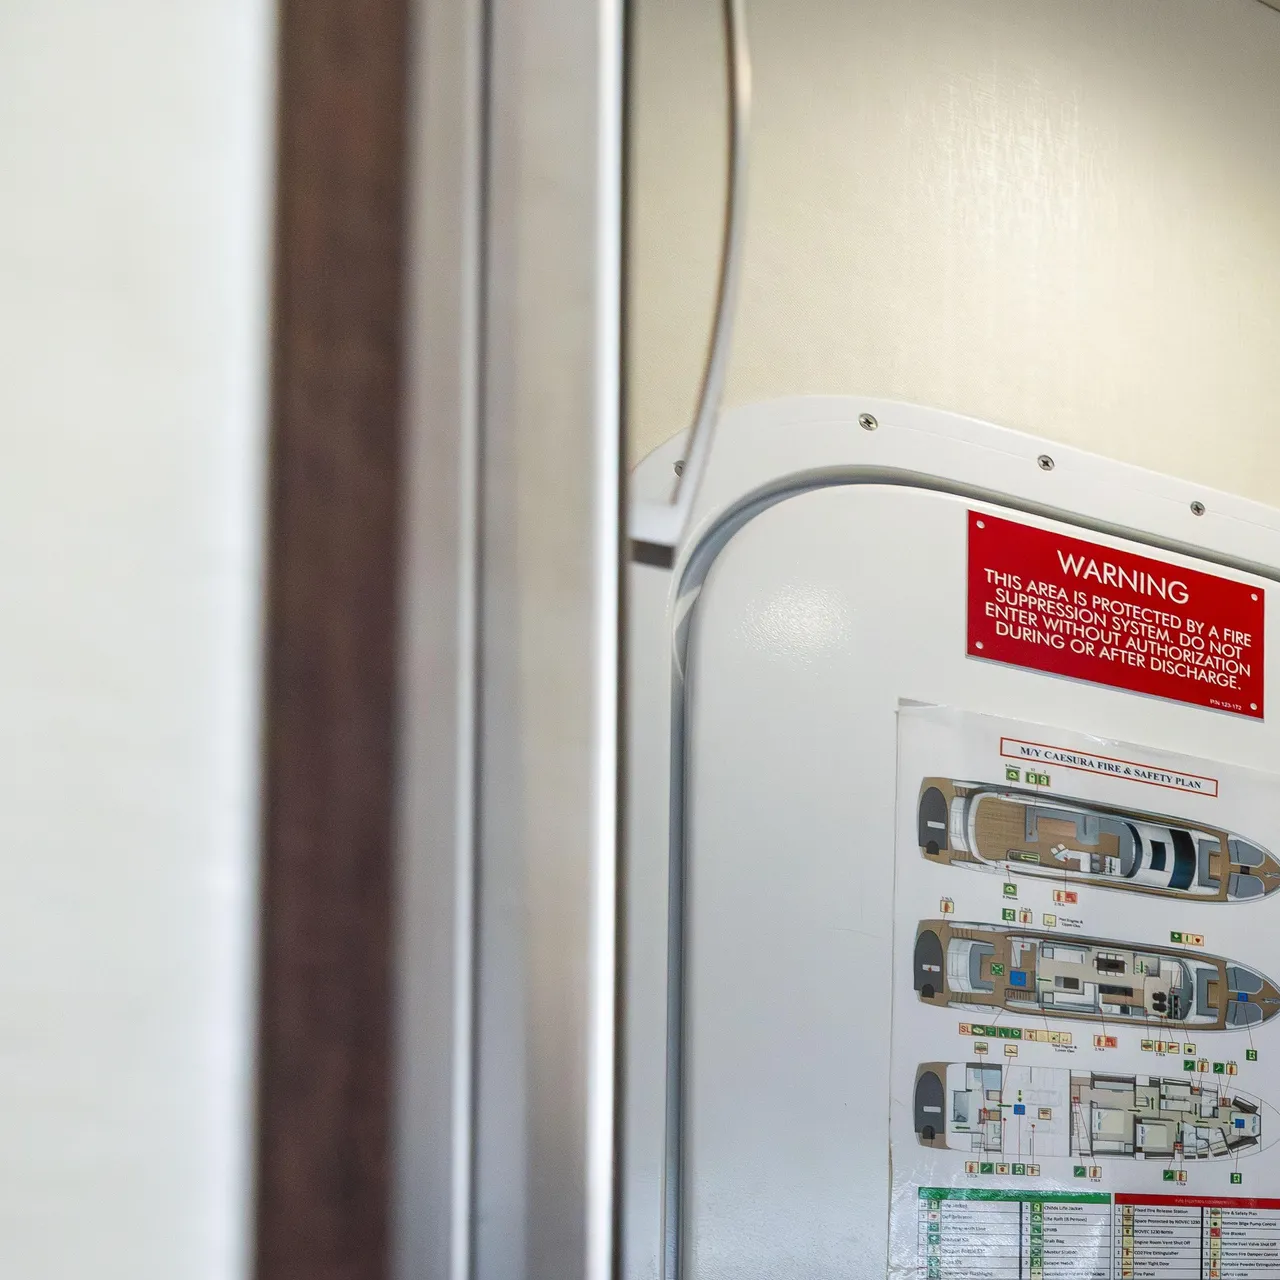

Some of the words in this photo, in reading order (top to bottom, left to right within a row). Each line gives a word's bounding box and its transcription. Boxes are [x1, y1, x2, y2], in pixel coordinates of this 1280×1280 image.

[984, 568, 1022, 591] THIS
[1026, 580, 1068, 601] AREA
[1074, 591, 1087, 606] IS
[1092, 596, 1182, 630] PROTECTED
[1186, 619, 1204, 634] BY
[1208, 625, 1219, 639] A
[1224, 628, 1251, 648] FIRE
[1057, 550, 1190, 604] WARNING
[986, 602, 1037, 628] ENTER
[1043, 615, 1121, 646] WITHOUT
[1126, 637, 1250, 677] AUTHORIZATION
[995, 588, 1106, 628] SUPPRESSION
[1112, 616, 1174, 643] SYSTEM.
[1180, 632, 1204, 651] DO
[1210, 639, 1242, 660] NOT
[996, 620, 1065, 650] DURING
[1070, 639, 1095, 657] OR
[1100, 646, 1145, 670] AFTER
[1150, 659, 1242, 690] DISCHARGE.
[1020, 746, 1040, 758] M/Y
[1044, 751, 1094, 768] CAESURA
[1098, 762, 1121, 773] FIRE
[1134, 770, 1172, 784] SAFETY
[1175, 777, 1202, 789] PLAN
